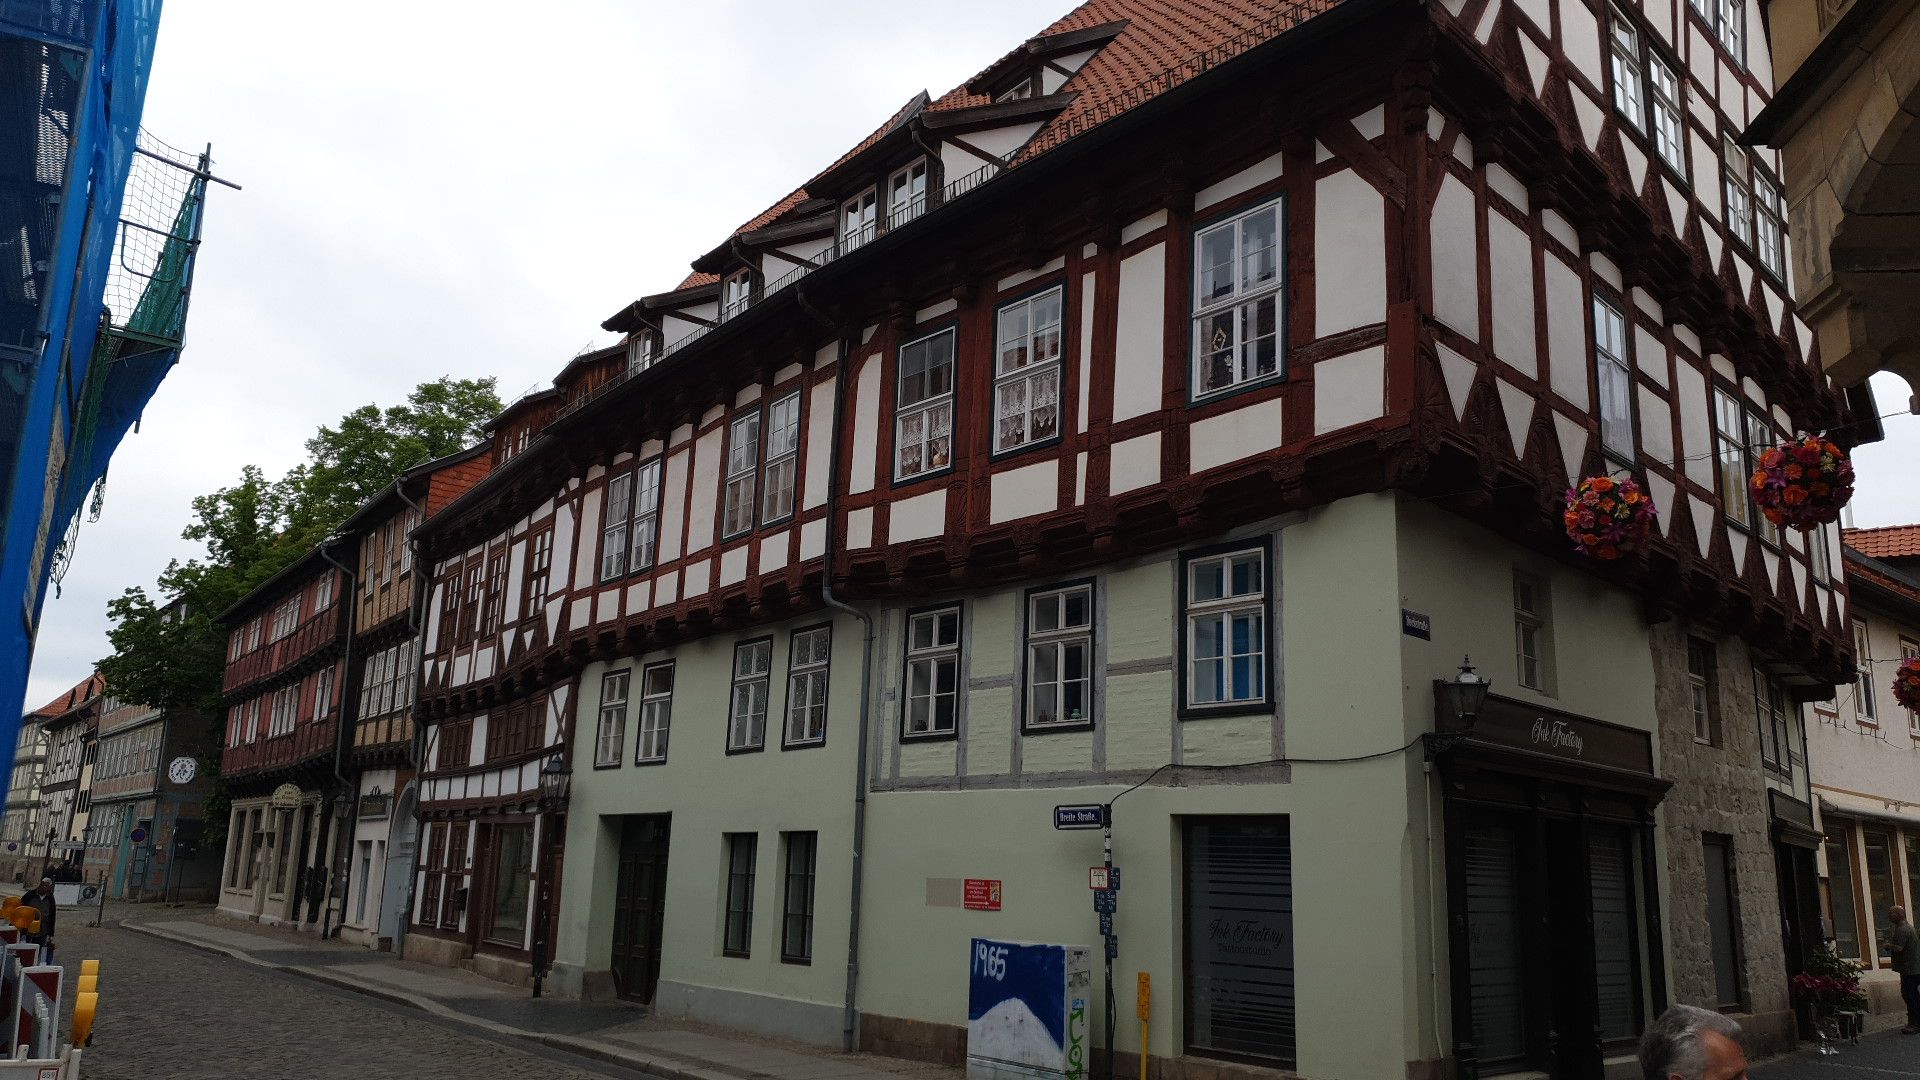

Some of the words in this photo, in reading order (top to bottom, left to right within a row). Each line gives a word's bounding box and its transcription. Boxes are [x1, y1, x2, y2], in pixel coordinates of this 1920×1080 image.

[1531, 717, 1550, 743] Ink
[1550, 721, 1583, 755] Factory
[1059, 812, 1076, 822] Breite
[1209, 919, 1231, 939] Ink
[1233, 920, 1283, 949] Factory
[974, 941, 1009, 982] 1965
